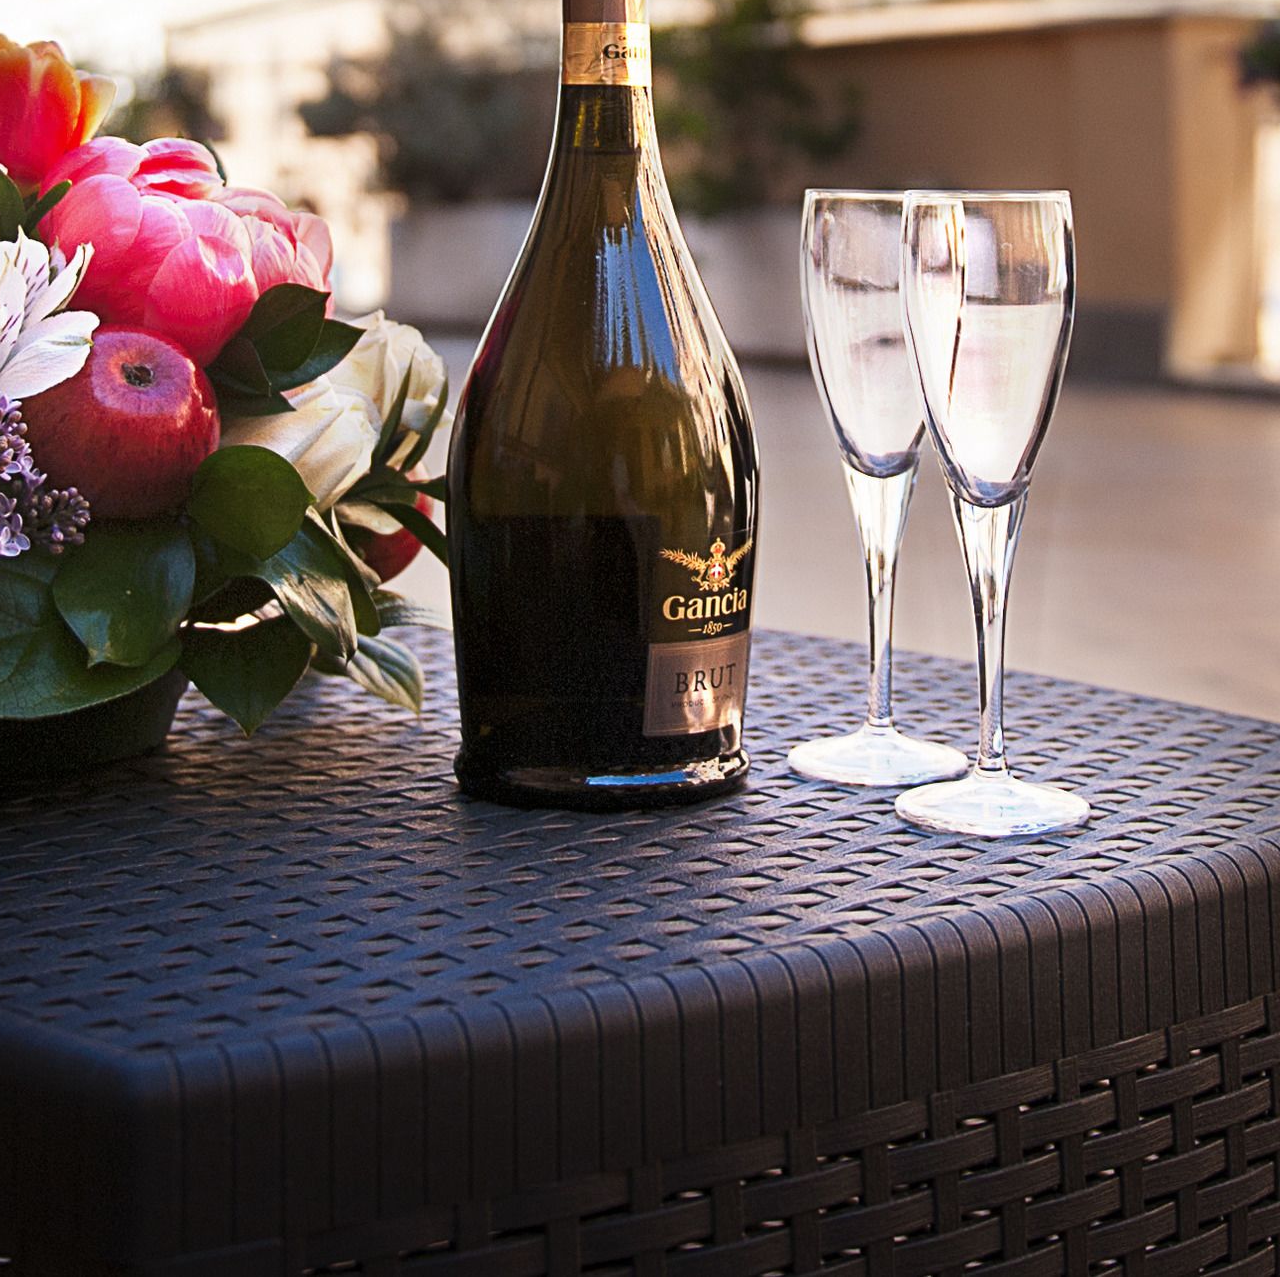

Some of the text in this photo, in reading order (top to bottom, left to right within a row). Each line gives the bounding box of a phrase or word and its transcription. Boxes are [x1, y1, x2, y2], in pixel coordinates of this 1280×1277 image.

[663, 587, 747, 620] Gancia
[702, 621, 722, 635] 1850
[675, 663, 736, 693] BRUT
